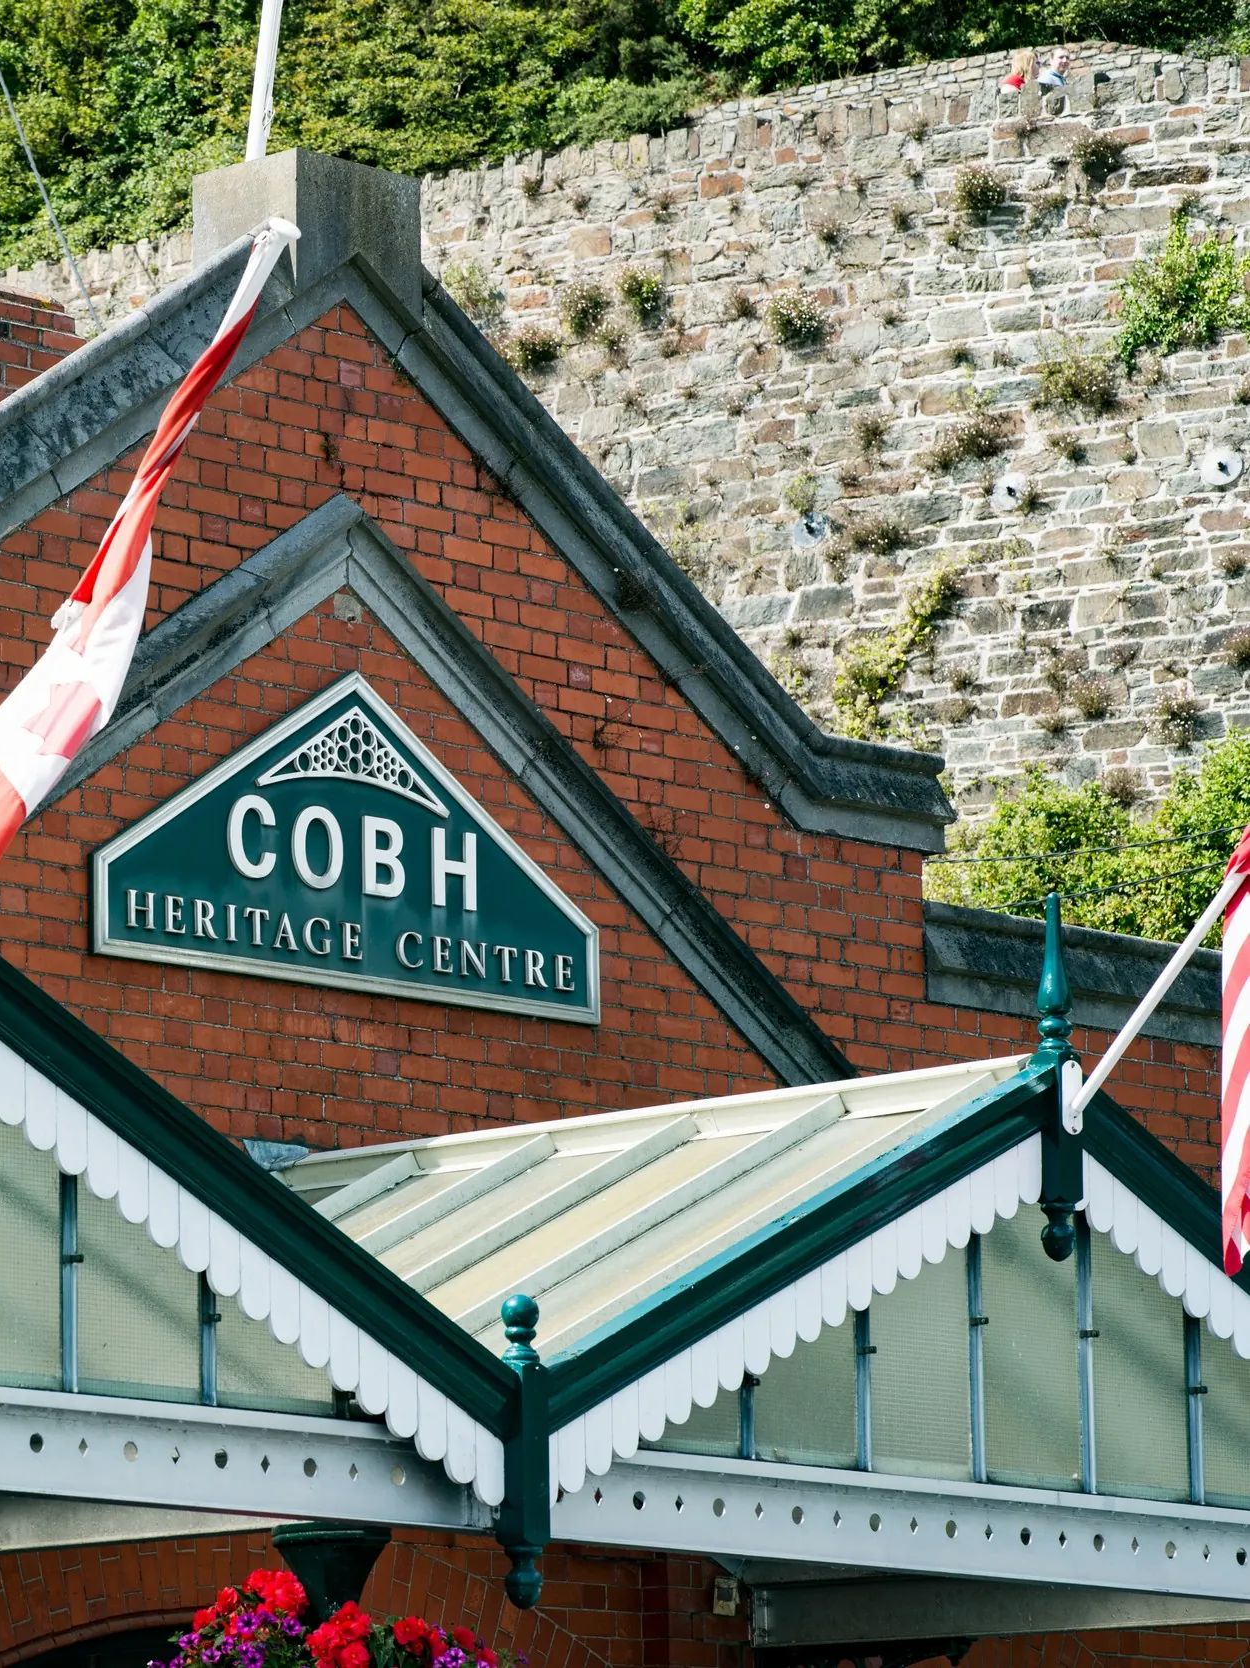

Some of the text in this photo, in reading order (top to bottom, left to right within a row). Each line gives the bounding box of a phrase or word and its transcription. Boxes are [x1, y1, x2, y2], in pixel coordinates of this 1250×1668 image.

[227, 794, 478, 912] COBH
[125, 888, 575, 992] HERITAGE CENTRE
